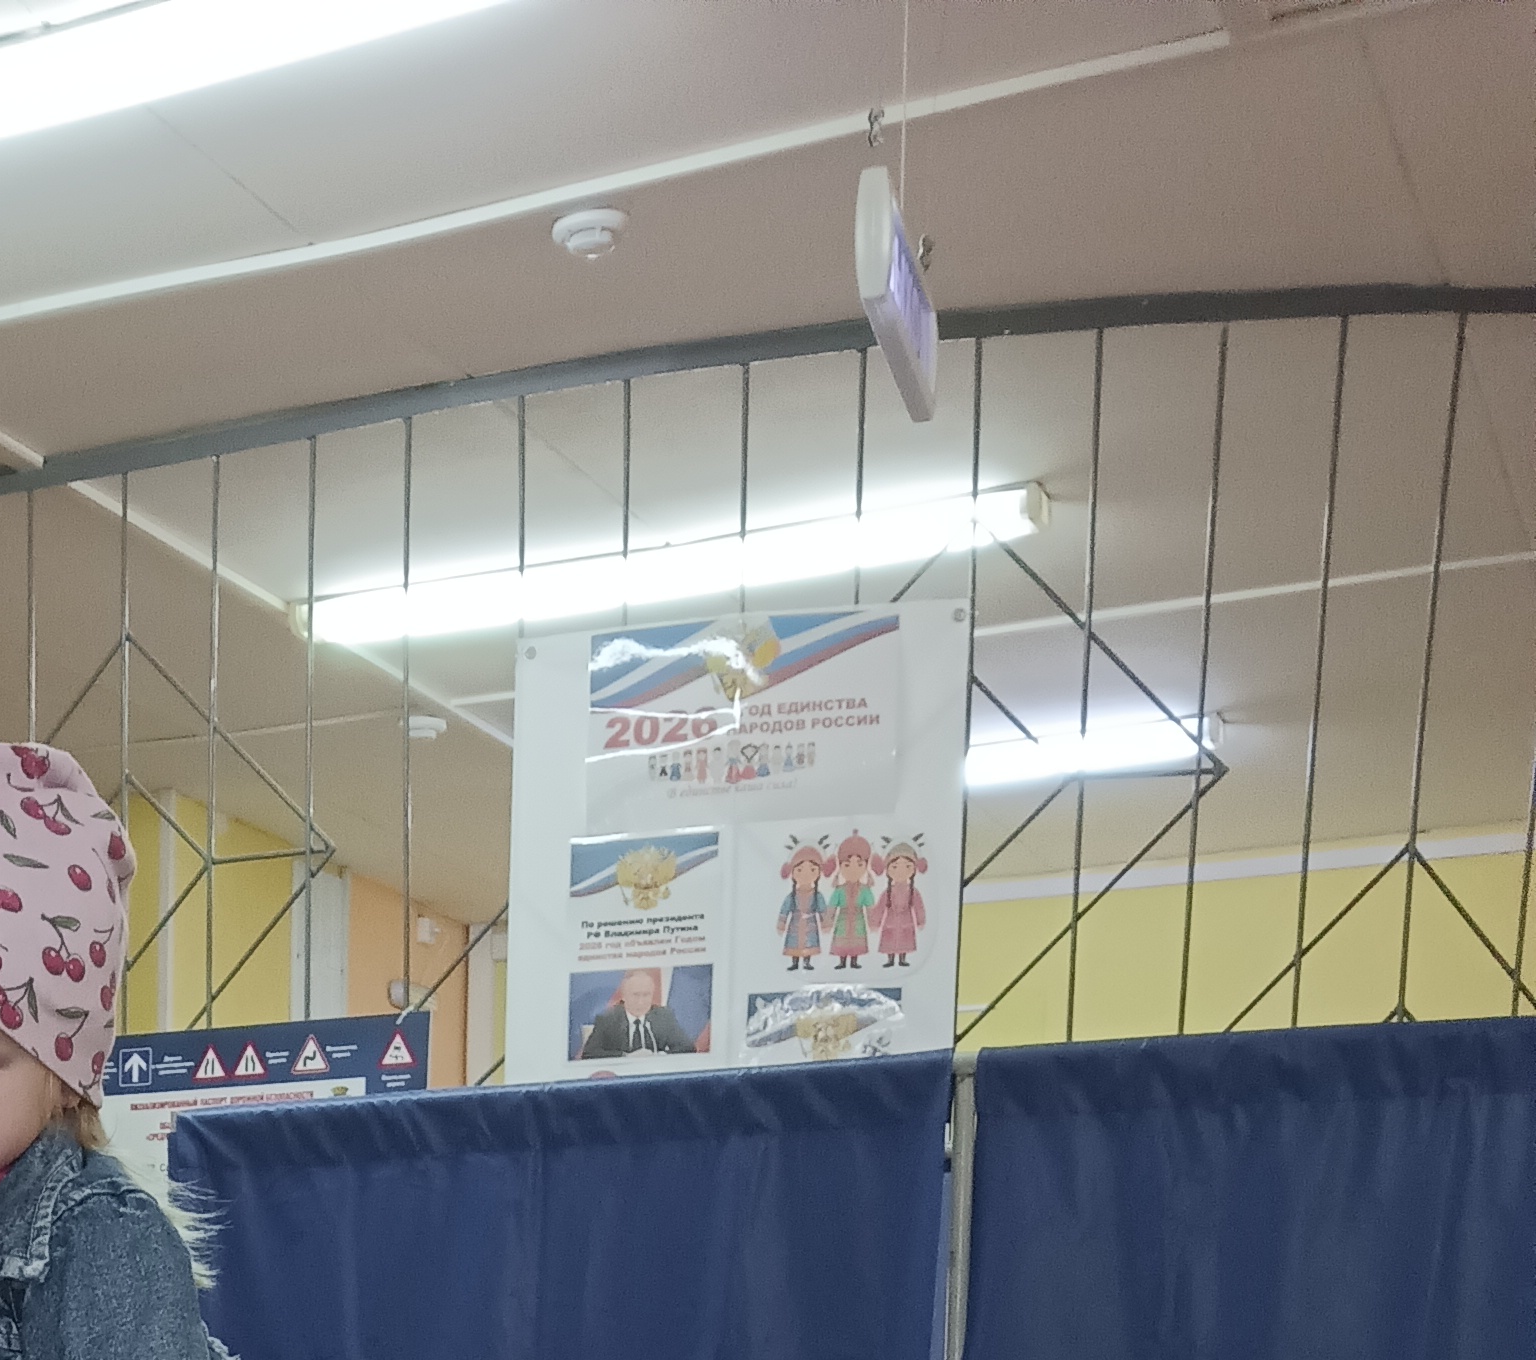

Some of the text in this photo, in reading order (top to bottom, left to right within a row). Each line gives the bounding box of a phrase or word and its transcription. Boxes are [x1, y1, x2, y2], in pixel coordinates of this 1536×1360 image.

[740, 698, 868, 717] ОД ЕДИНСТВА
[603, 706, 718, 750] 2026
[811, 714, 880, 729] РОССИИ
[581, 921, 594, 929] По
[646, 913, 705, 924] президента
[604, 928, 660, 938] Владимира
[662, 924, 699, 935] Путина
